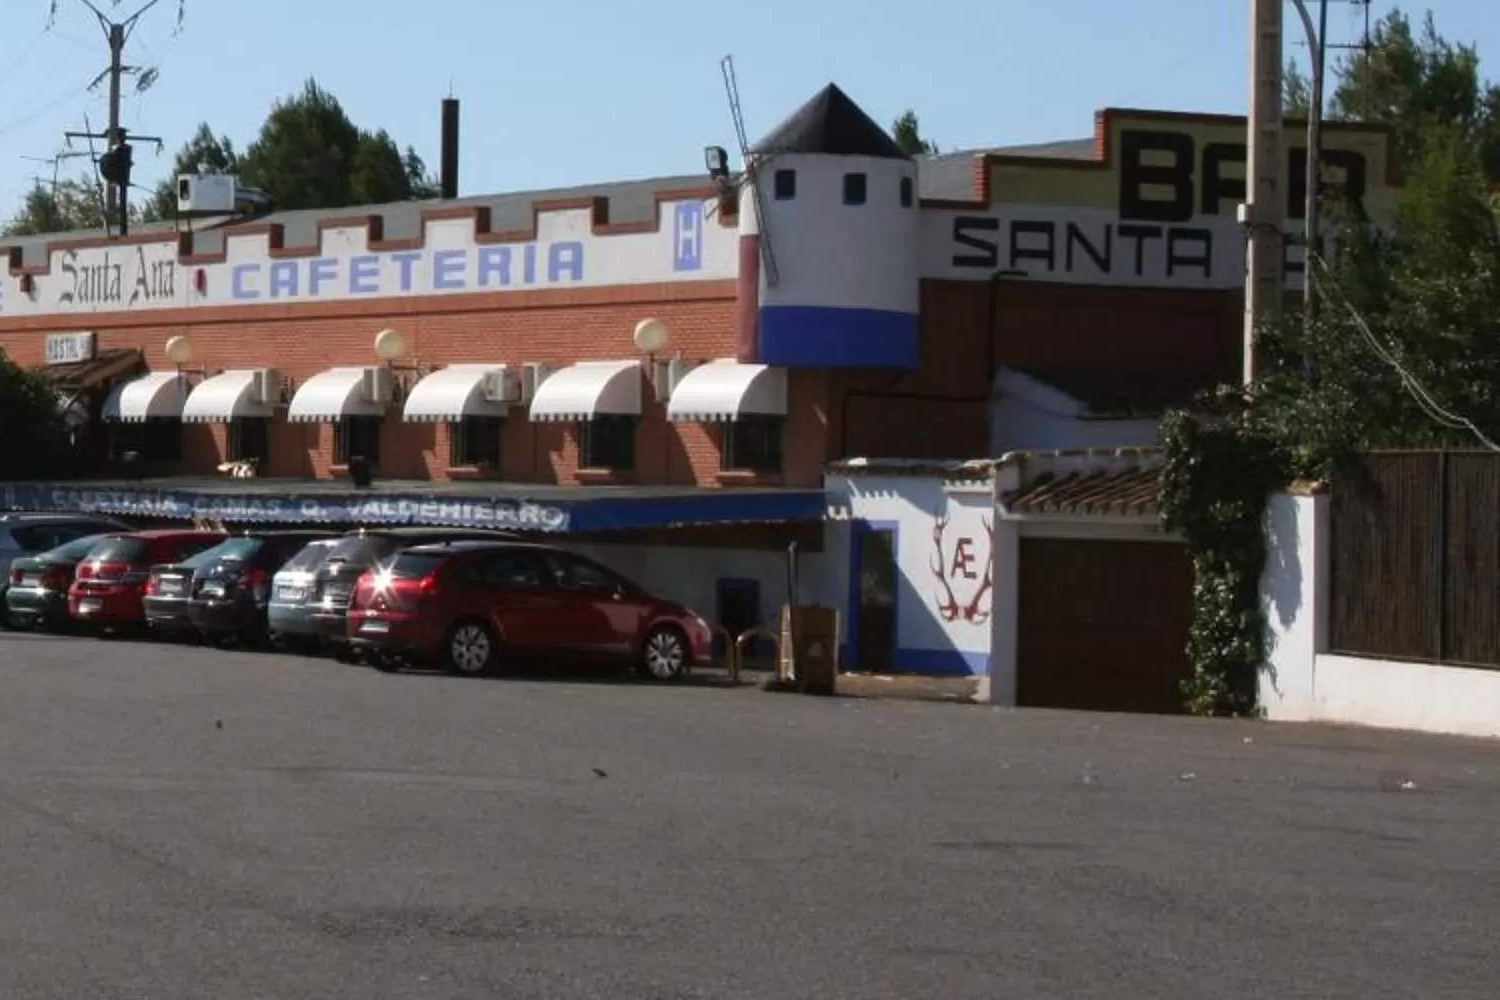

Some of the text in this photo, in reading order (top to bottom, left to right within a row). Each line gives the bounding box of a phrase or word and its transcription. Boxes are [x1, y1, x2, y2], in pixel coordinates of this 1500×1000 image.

[59, 245, 176, 306] Santa Ana
[232, 240, 584, 299] CAFETERIA
[953, 216, 1212, 278] SANTA
